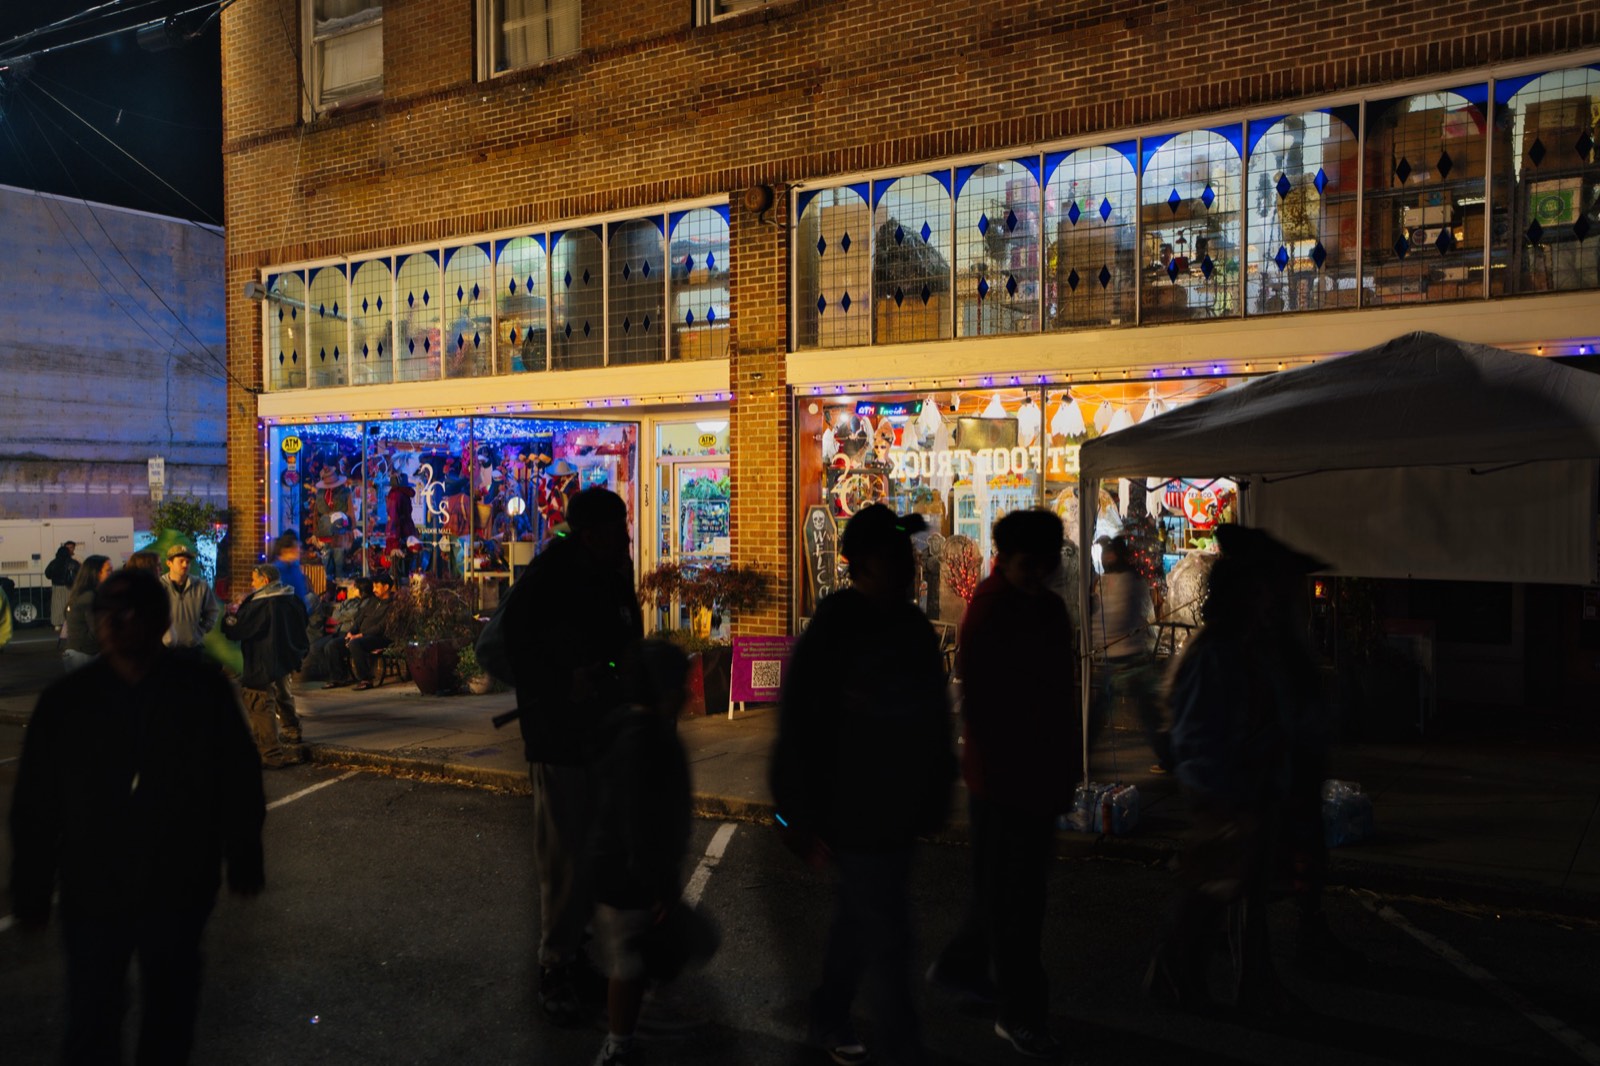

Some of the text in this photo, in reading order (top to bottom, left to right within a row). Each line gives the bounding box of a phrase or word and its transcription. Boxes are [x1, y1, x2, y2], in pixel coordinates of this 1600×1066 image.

[858, 406, 875, 414] ATM
[879, 406, 907, 415] Inside
[285, 438, 299, 448] ATM
[812, 530, 831, 600] WELCO
